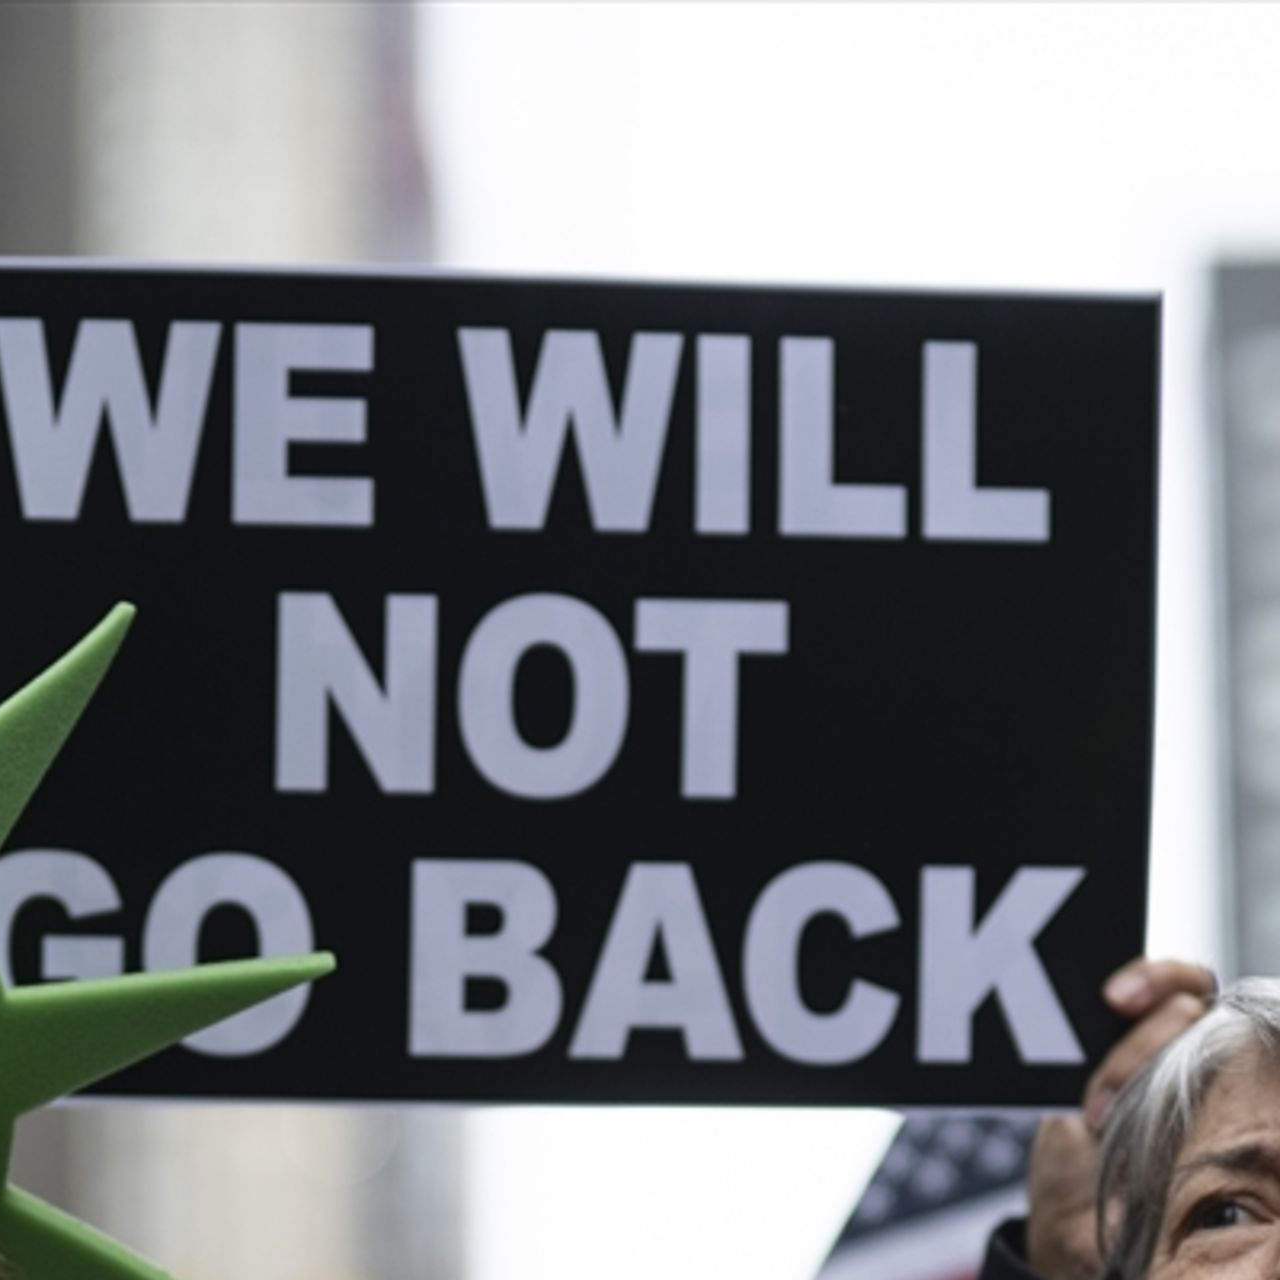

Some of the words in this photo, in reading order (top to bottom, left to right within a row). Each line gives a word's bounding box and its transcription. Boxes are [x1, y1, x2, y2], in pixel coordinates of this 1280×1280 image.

[457, 327, 1050, 542] WILL
[275, 592, 789, 799] NOT
[408, 858, 1088, 1064] BACK
